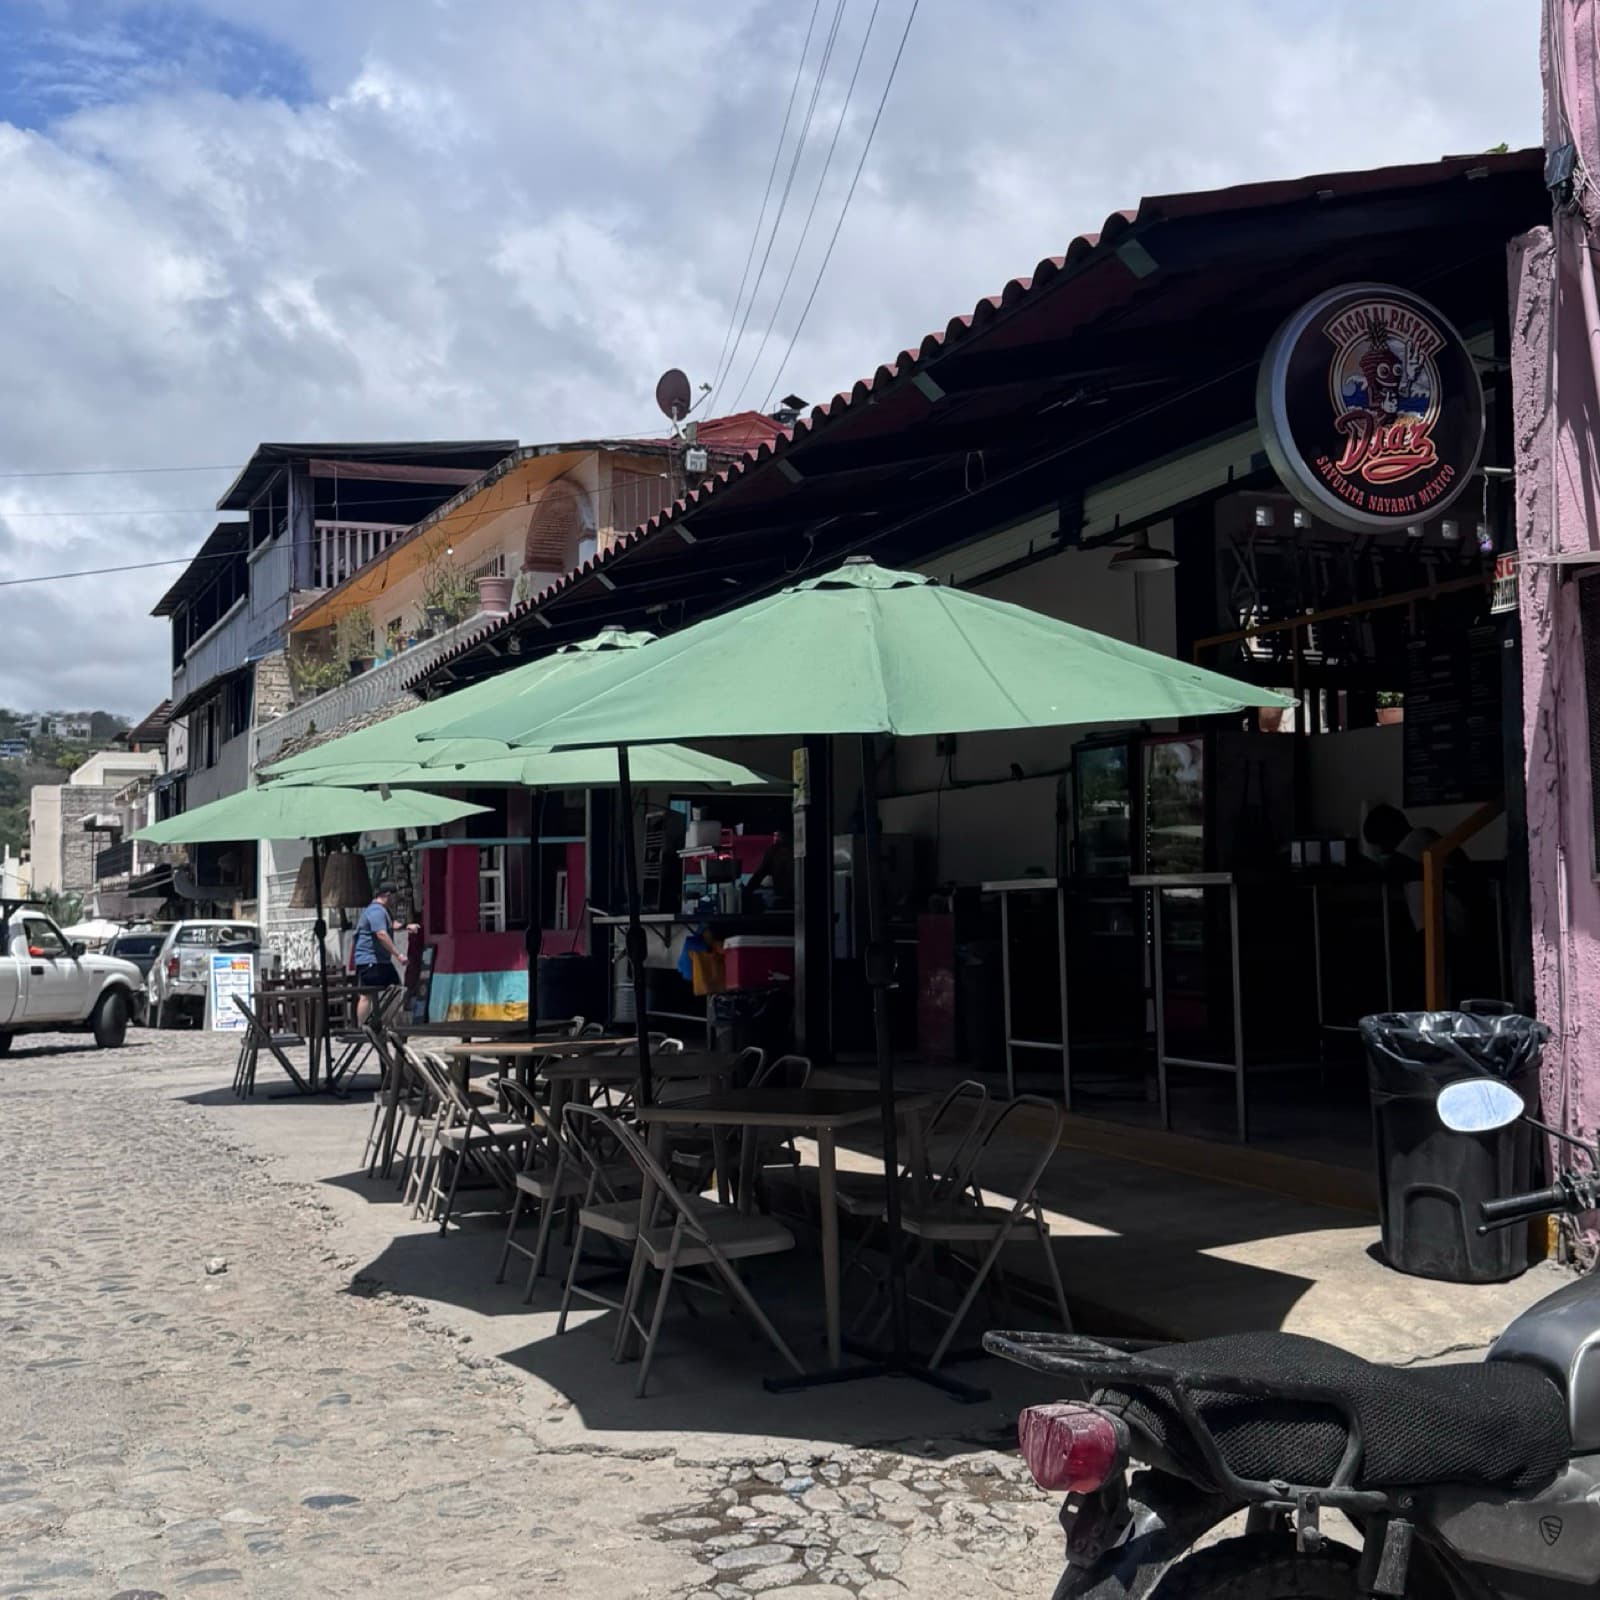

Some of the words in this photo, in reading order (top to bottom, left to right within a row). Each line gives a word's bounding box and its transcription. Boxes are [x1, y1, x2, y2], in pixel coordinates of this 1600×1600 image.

[1332, 307, 1369, 344] TACOS
[1389, 308, 1437, 353] PASTOR
[1316, 455, 1365, 506] SAYULITA
[1367, 494, 1417, 513] NAYARIT
